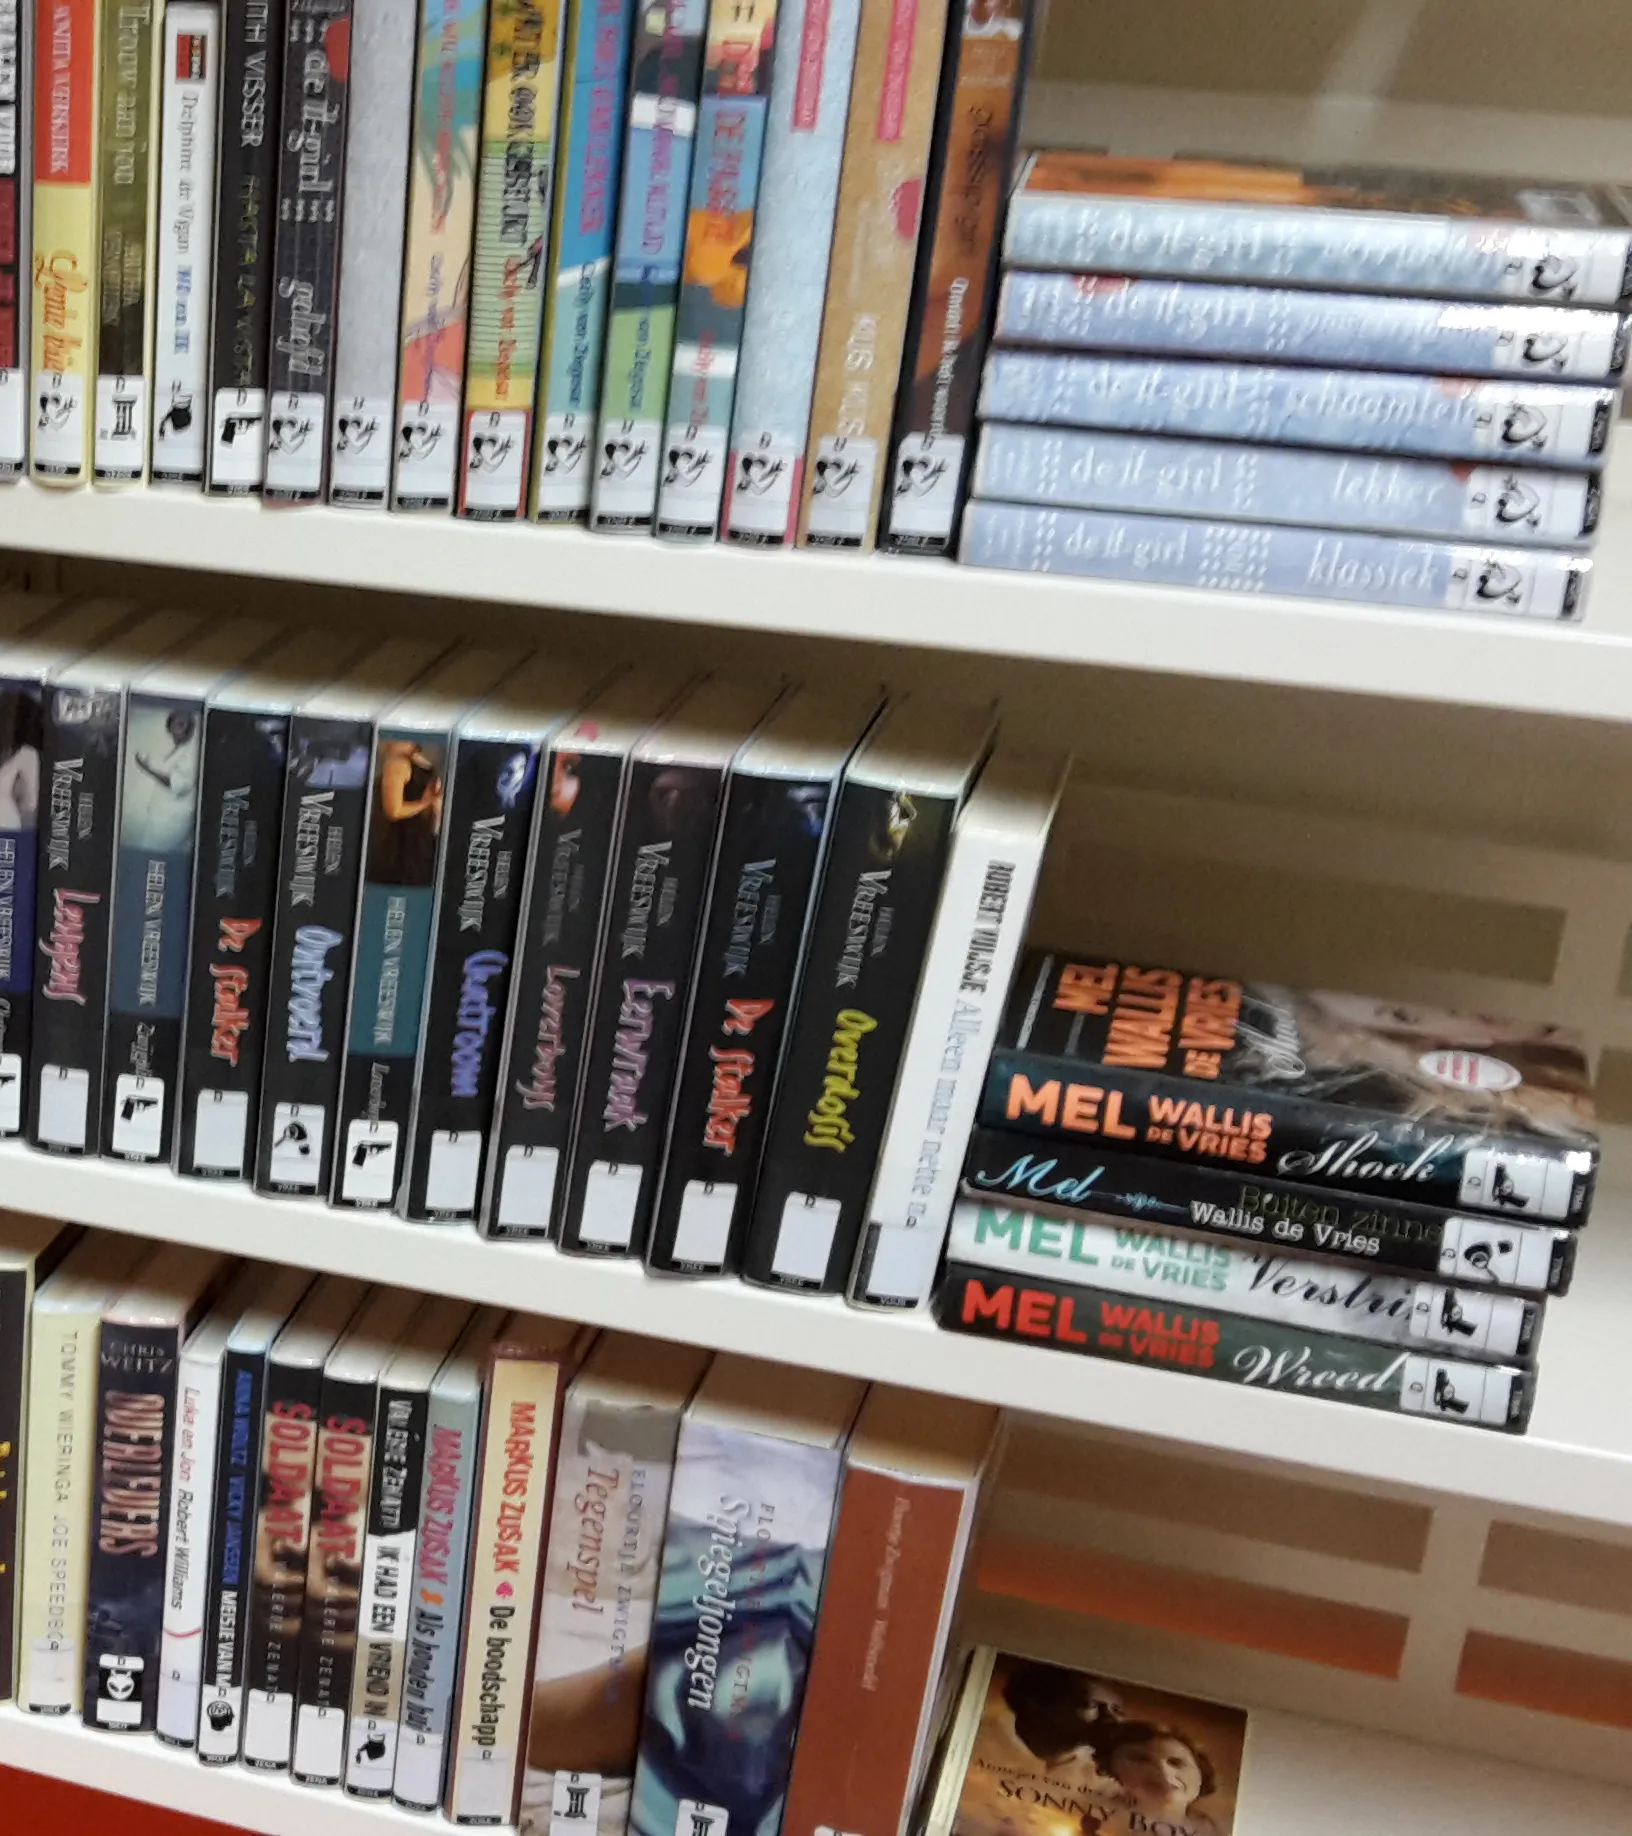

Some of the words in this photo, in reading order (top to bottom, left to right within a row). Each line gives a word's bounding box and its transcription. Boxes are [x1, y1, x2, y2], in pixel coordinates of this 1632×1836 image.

[114, 3, 154, 91] Trouw
[303, 49, 330, 95] de
[115, 91, 139, 138] aan
[240, 51, 267, 148] VISSER
[104, 140, 147, 185] jou
[174, 204, 197, 255] Vigan
[845, 314, 881, 371] KUS
[836, 380, 868, 436] KUS
[1071, 446, 1115, 487] de
[1332, 462, 1441, 503] lekker
[1064, 522, 1094, 558] de
[1306, 531, 1440, 590] klassiek
[47, 757, 86, 872] VREESWIJK
[77, 792, 94, 839] HELEN
[215, 785, 252, 899] VREESWIJK
[243, 820, 257, 867] HELEN
[289, 790, 336, 908] VREESWIJK
[324, 825, 343, 876] HELEN
[457, 814, 506, 932] VREESWIJK
[493, 850, 514, 900] HELEN
[144, 859, 166, 916] HELEN
[541, 827, 582, 946] VREESWIJK
[620, 840, 674, 959] VREESWIJK
[656, 876, 680, 927] HELEN
[976, 860, 1017, 925] ROBERT
[38, 887, 102, 1006] Leugens
[217, 916, 263, 953] De
[382, 896, 407, 953] HELEN
[722, 858, 777, 978] VREESWIJK
[760, 894, 782, 945] HELEN
[834, 867, 892, 989] VREESWIJK
[871, 906, 896, 959] HELEN
[138, 918, 165, 1006] VREESWIJK
[958, 927, 1000, 996] VUIJSJE
[1052, 962, 1119, 1015] MEL
[287, 924, 344, 1064] Ontvoerd
[373, 956, 402, 1047] VREESWIJK
[450, 949, 509, 1098] Chatroom
[720, 998, 775, 1036] De
[1101, 964, 1184, 1069] WALLIS
[1177, 976, 1245, 1050] VRIES
[515, 964, 581, 1113] Loverboys
[602, 978, 675, 1132] Eerwraak
[940, 998, 984, 1072] Alleen
[1182, 1049, 1222, 1080] DE
[804, 1008, 879, 1154] Overdosis
[924, 1076, 960, 1134] maar
[1005, 1072, 1137, 1141] MEL
[1147, 1093, 1274, 1141] WALLIS
[1275, 1127, 1456, 1184] Shock
[1144, 1127, 1173, 1145] DE
[1176, 1127, 1269, 1165] VRIES
[911, 1137, 947, 1197] nette
[974, 1152, 1106, 1204] Mel
[1187, 1199, 1267, 1236] Wallis
[1273, 1216, 1306, 1243] de
[1313, 1222, 1382, 1257] Vries
[1236, 1183, 1343, 1228] Buiten
[972, 1204, 1099, 1267] MEL
[1113, 1227, 1232, 1267] WALLIS
[1111, 1256, 1136, 1271] DE
[1141, 1256, 1229, 1293] VRIES
[59, 1329, 79, 1400] TOMMY
[961, 1277, 1088, 1345] MEL
[1100, 1301, 1221, 1347] WALLIS
[1230, 1346, 1414, 1394] Wreed
[1097, 1332, 1124, 1347] DE
[1129, 1333, 1216, 1370] VRIES
[180, 1386, 202, 1426] Luke
[54, 1409, 76, 1502] WIERINGA
[177, 1452, 197, 1481] Jon
[180, 1428, 196, 1450] en
[502, 1400, 538, 1497] MARKUS
[97, 1390, 167, 1559] OVERLEVERS
[228, 1475, 248, 1518] VICKY
[264, 1402, 314, 1550] SOLDAAT
[317, 1415, 370, 1560] SOLDAAT
[425, 1426, 465, 1513] MARKUS
[50, 1513, 69, 1549] JOE
[173, 1487, 194, 1543] Robert
[493, 1500, 525, 1573] ZUSAK
[566, 1466, 621, 1615] Tegenspel
[617, 1468, 648, 1574] FLOORTJE
[169, 1546, 191, 1611] Williams
[382, 1546, 402, 1563] IK
[420, 1516, 455, 1585] ZUSAK
[373, 1564, 401, 1599] HAD
[683, 1494, 753, 1712] Spiegeljongen
[217, 1590, 239, 1642] MEISJE
[370, 1603, 398, 1633] EEN
[413, 1607, 444, 1636] Als
[488, 1605, 516, 1632] De
[216, 1641, 235, 1671] VAN
[366, 1641, 394, 1696] VRIEND
[406, 1639, 437, 1697] honden
[996, 1777, 1118, 1823] SONNY
